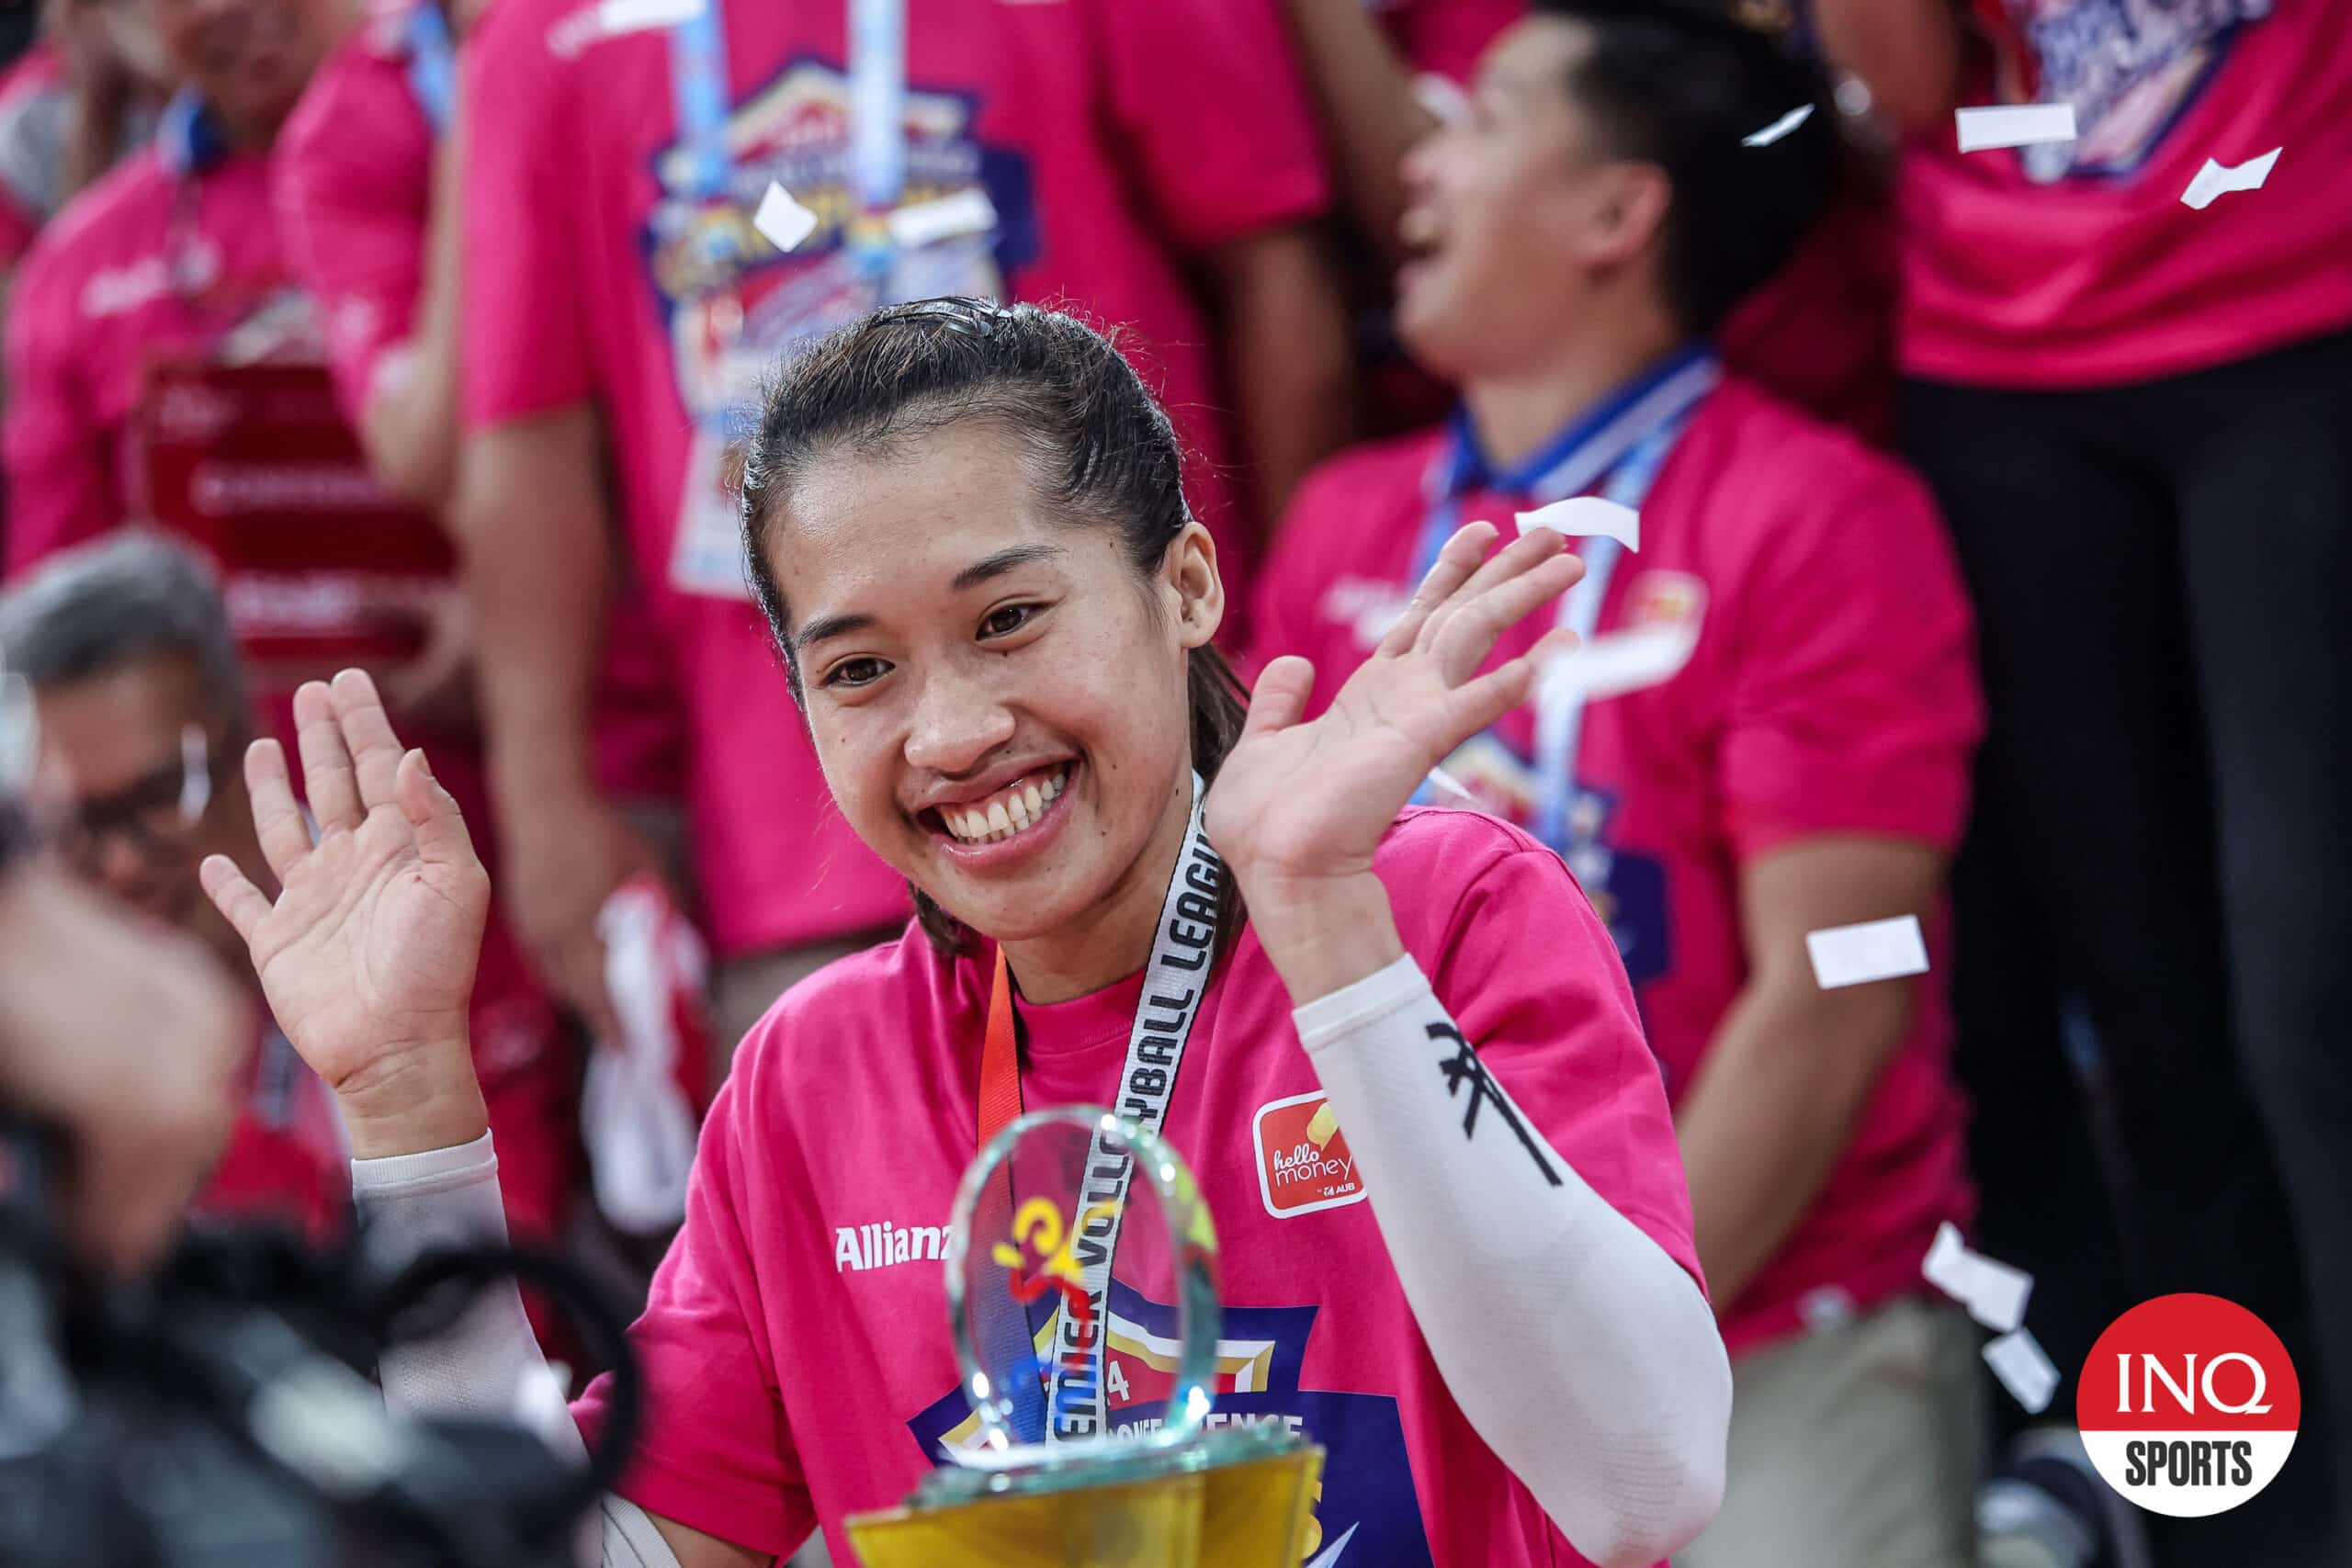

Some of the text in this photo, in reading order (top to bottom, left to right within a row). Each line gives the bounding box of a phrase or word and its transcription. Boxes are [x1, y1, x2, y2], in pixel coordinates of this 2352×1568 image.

[1273, 1143, 1320, 1171] hello
[1275, 1155, 1354, 1187] money
[1053, 1290, 1103, 1442] EMIER
